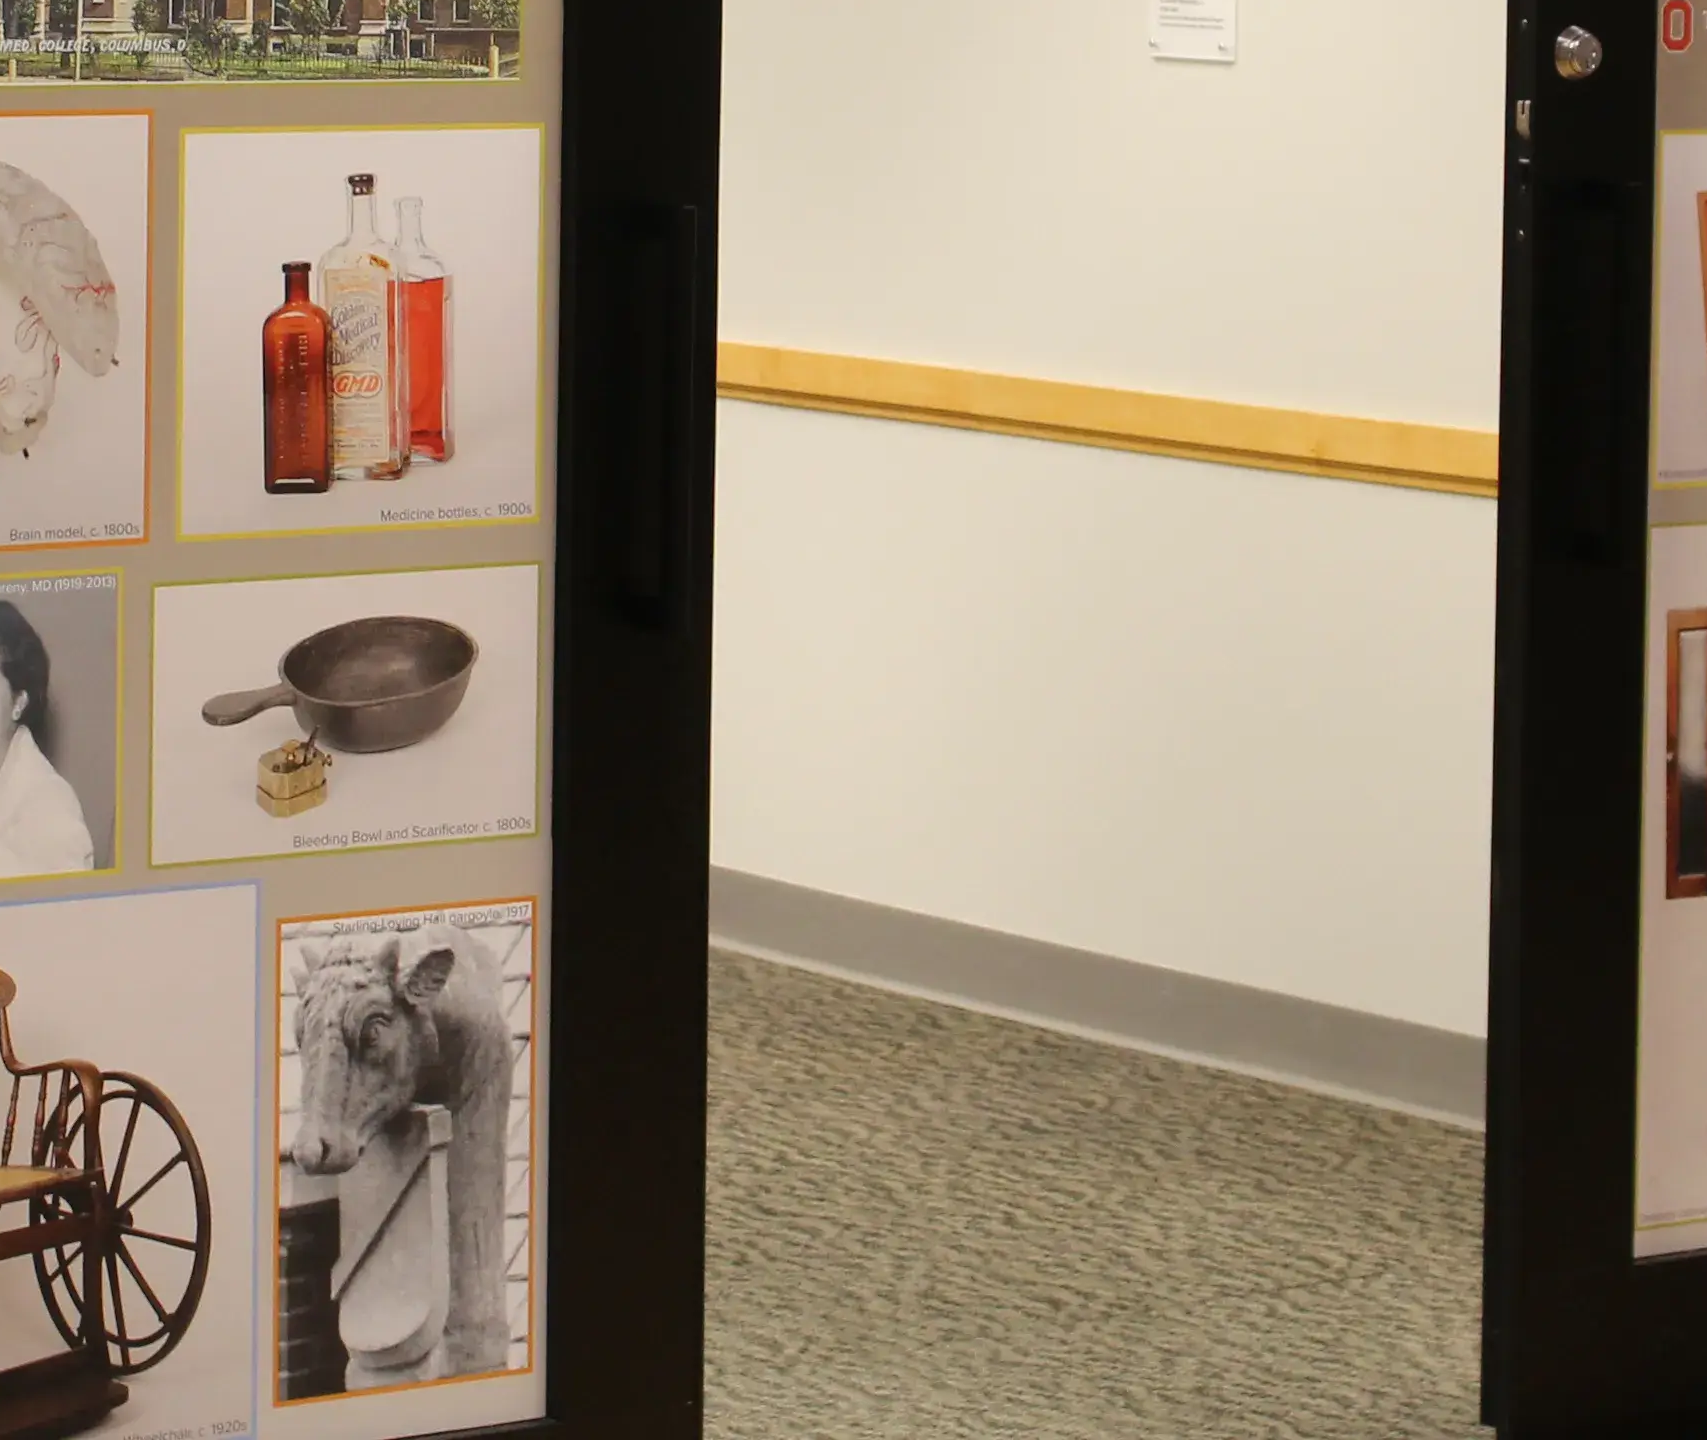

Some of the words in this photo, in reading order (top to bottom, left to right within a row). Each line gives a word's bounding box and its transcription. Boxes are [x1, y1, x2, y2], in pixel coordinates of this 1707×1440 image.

[0, 39, 33, 53] MED.
[38, 39, 96, 55] COLLEGE,
[338, 312, 379, 345] Medical
[330, 331, 383, 366] Discovery
[335, 373, 381, 393] GMD
[380, 508, 435, 523] Medicine
[438, 506, 482, 520] bottles,
[497, 502, 533, 516] 1900s
[10, 528, 42, 542] Brain
[45, 526, 87, 539] model,
[104, 522, 141, 537] 1800s
[32, 579, 52, 592] MD
[54, 575, 117, 593] (1919-2013)
[293, 834, 349, 849] Bleeding
[351, 830, 383, 844] Bowl
[385, 827, 408, 840] and
[411, 823, 479, 839] Scarificator
[496, 816, 532, 831] 1800s
[333, 915, 420, 934] Starling-Loving
[423, 911, 446, 926] Hall
[505, 904, 530, 919] 1917
[211, 1418, 248, 1435] 1920s
